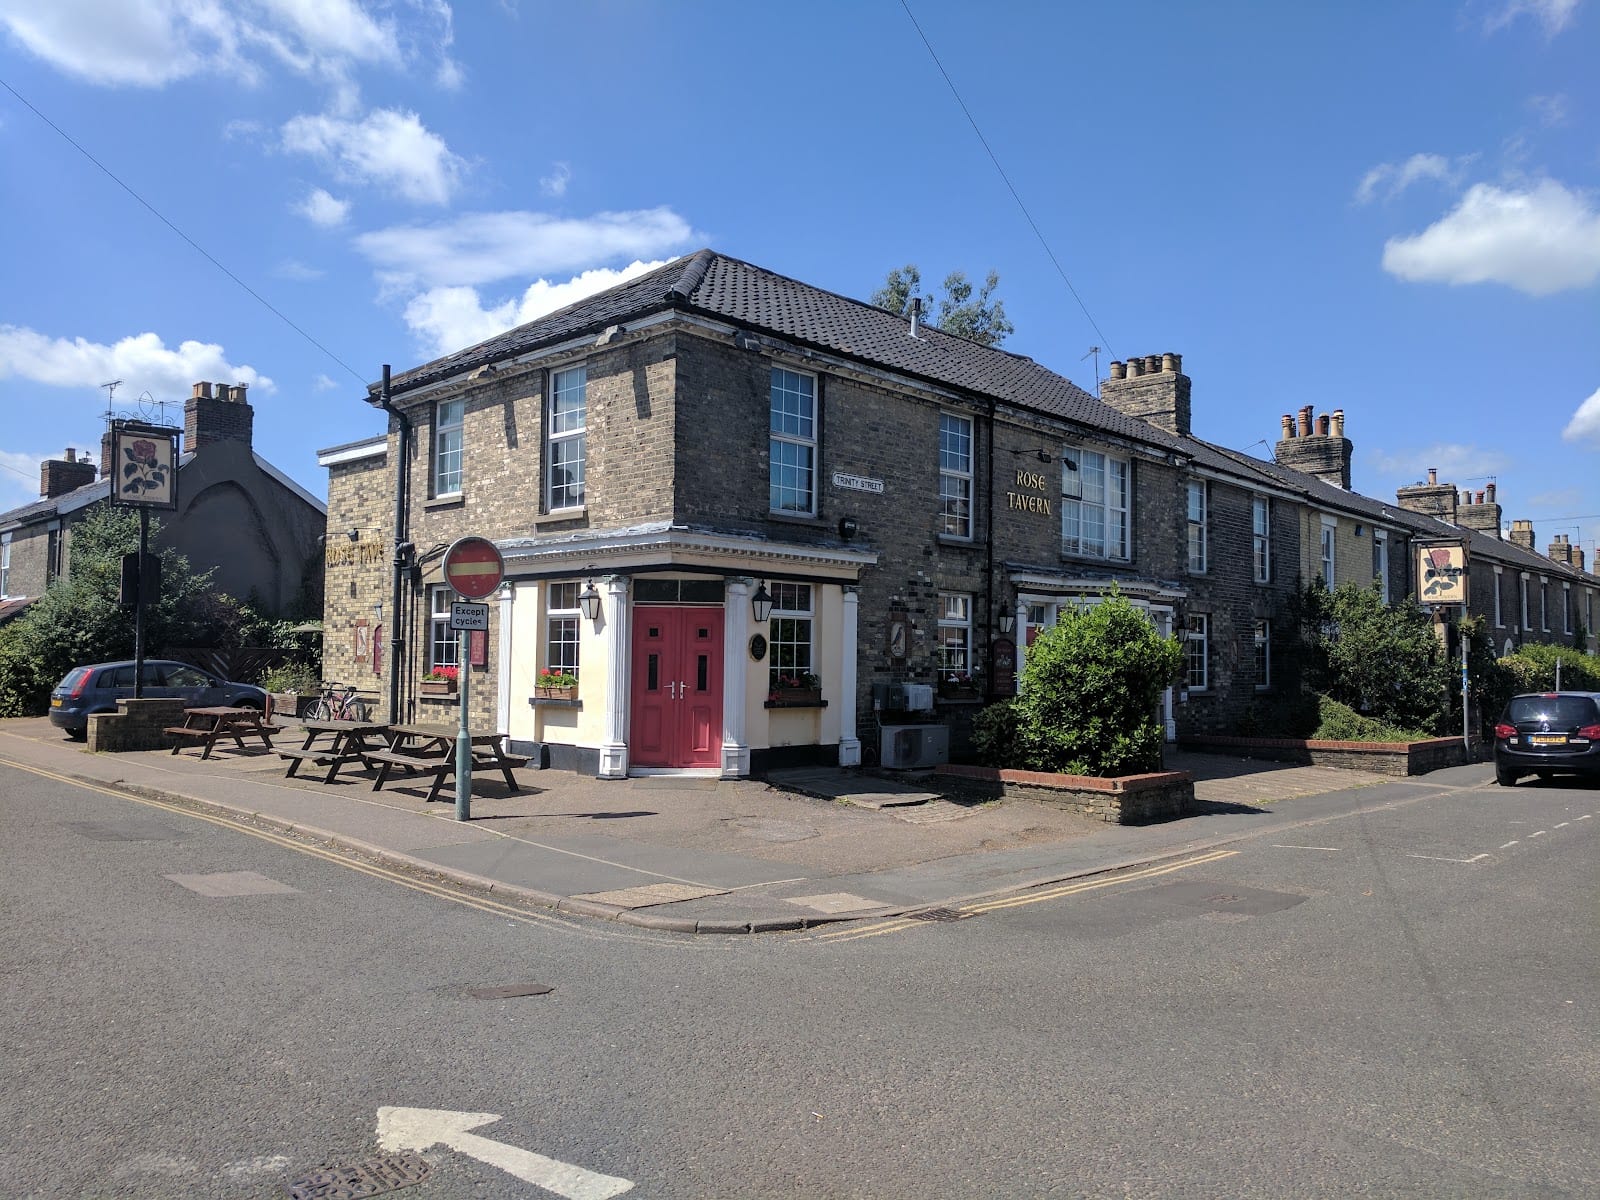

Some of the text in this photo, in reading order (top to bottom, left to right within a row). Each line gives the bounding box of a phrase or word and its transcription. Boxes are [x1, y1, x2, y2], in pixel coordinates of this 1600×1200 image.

[836, 475, 882, 491] TRINITY STREET
[1016, 469, 1046, 491] ROSE
[1007, 491, 1052, 515] TAVERN
[455, 606, 485, 617] Except
[455, 617, 483, 626] cycles
